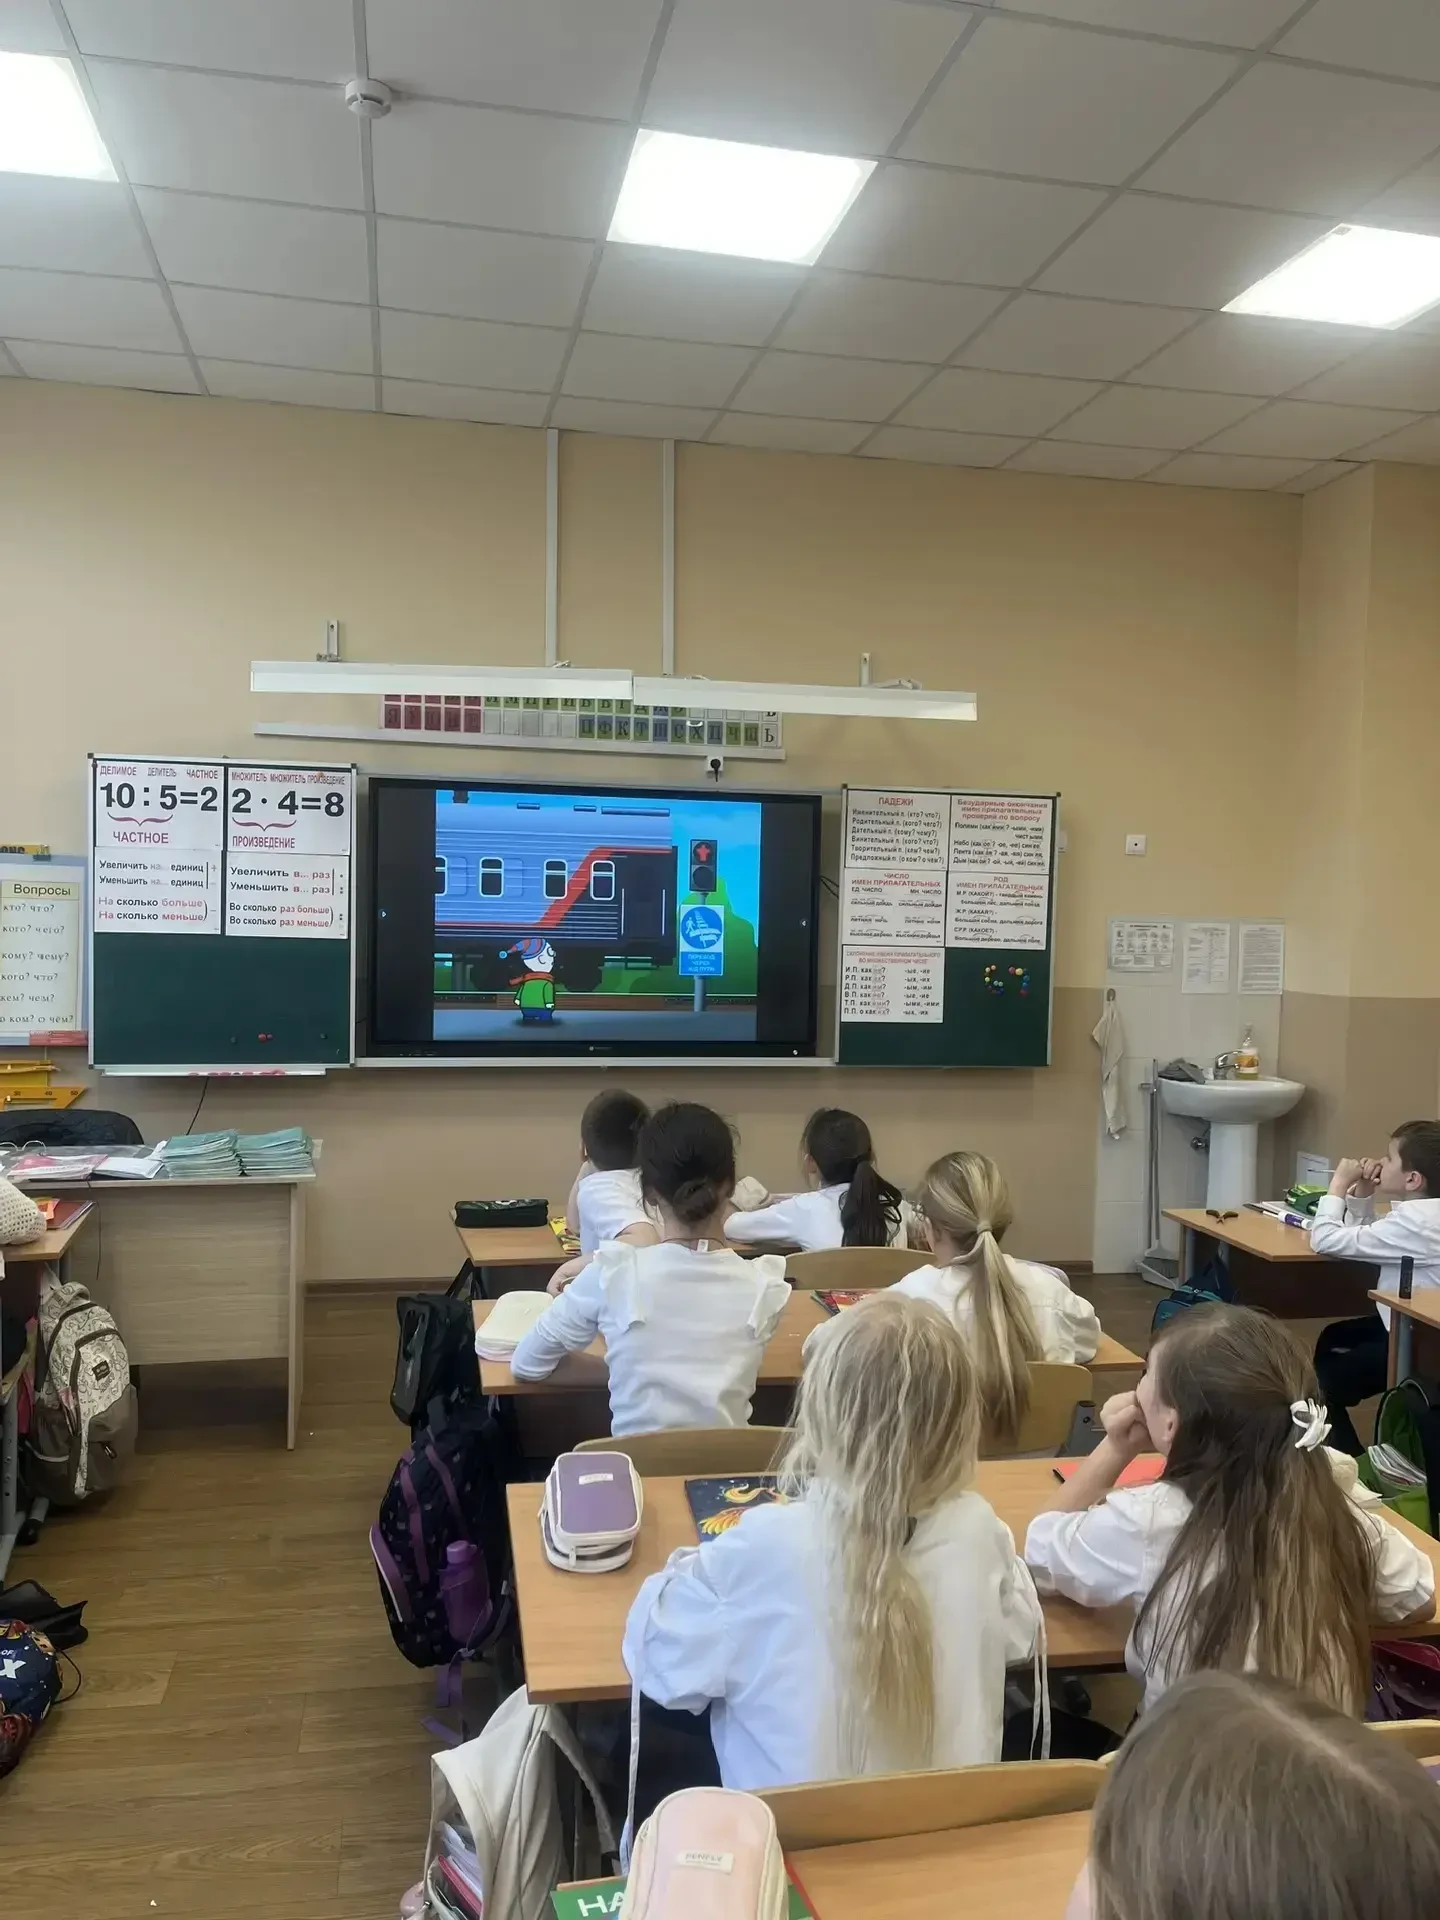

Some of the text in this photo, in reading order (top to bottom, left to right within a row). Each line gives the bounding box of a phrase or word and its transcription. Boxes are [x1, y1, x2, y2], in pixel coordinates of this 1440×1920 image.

[100, 765, 218, 779] ДЕЛИМОЕ ДЕЛИТЕЛЬ ЧАСТНОЕ
[231, 772, 267, 782] МНОЖИТЕЛЬ
[270, 773, 306, 784] МНОЖИТЕЛЬ
[878, 797, 914, 806] ПАДЕЖИ
[113, 831, 169, 844] ЧАСТНОЕ
[232, 835, 296, 848] ПРОИЗВЕДЕНИЕ
[99, 860, 148, 870] Увеличить
[170, 864, 204, 872] единиц
[230, 866, 289, 878] Увеличить
[312, 872, 330, 880] раз
[99, 875, 148, 886] Уменьшить
[170, 879, 204, 888] единиц
[13, 884, 71, 897] Вопросы
[230, 881, 288, 892] Уменьшить
[312, 887, 330, 895] раз
[3, 903, 54, 912] кто? что?
[99, 897, 202, 908] На сколько больше
[230, 902, 330, 914] Во сколько раз больше
[99, 911, 204, 921] На сколько меньше
[230, 916, 330, 928] Во сколько раз меньше
[2, 925, 65, 934] кого? чего?
[1, 951, 69, 962] кому? чему?
[1, 973, 58, 981] кого? что?
[28, 994, 54, 1002] чем?
[9, 1015, 34, 1023] ком?
